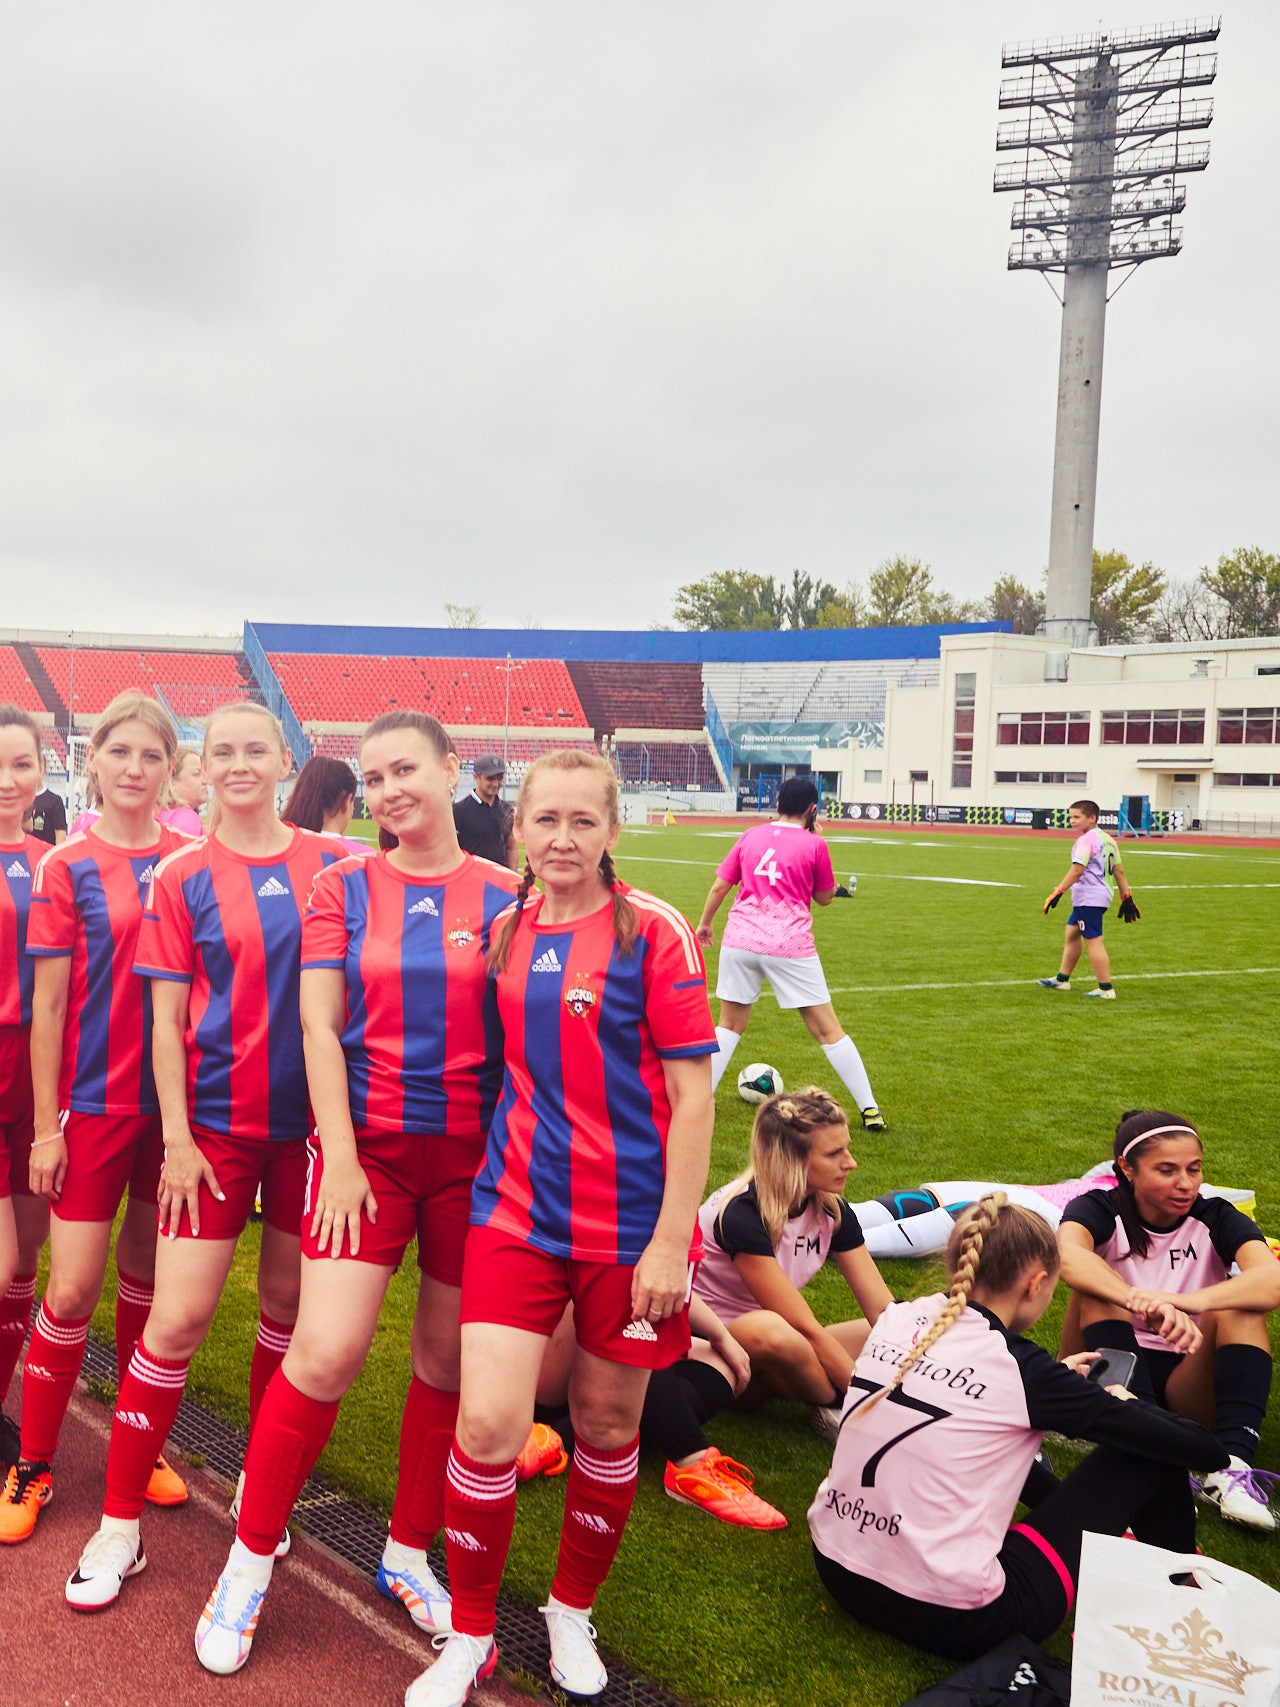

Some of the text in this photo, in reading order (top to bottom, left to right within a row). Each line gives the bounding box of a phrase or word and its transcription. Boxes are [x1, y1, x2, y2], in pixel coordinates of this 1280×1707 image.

[1097, 813, 1119, 825] ussia
[753, 847, 782, 887] 4
[566, 987, 594, 1004] ЦСКА
[794, 1231, 821, 1257] FM
[825, 1489, 902, 1537] Ковров
[1098, 1670, 1205, 1707] ROYAL
